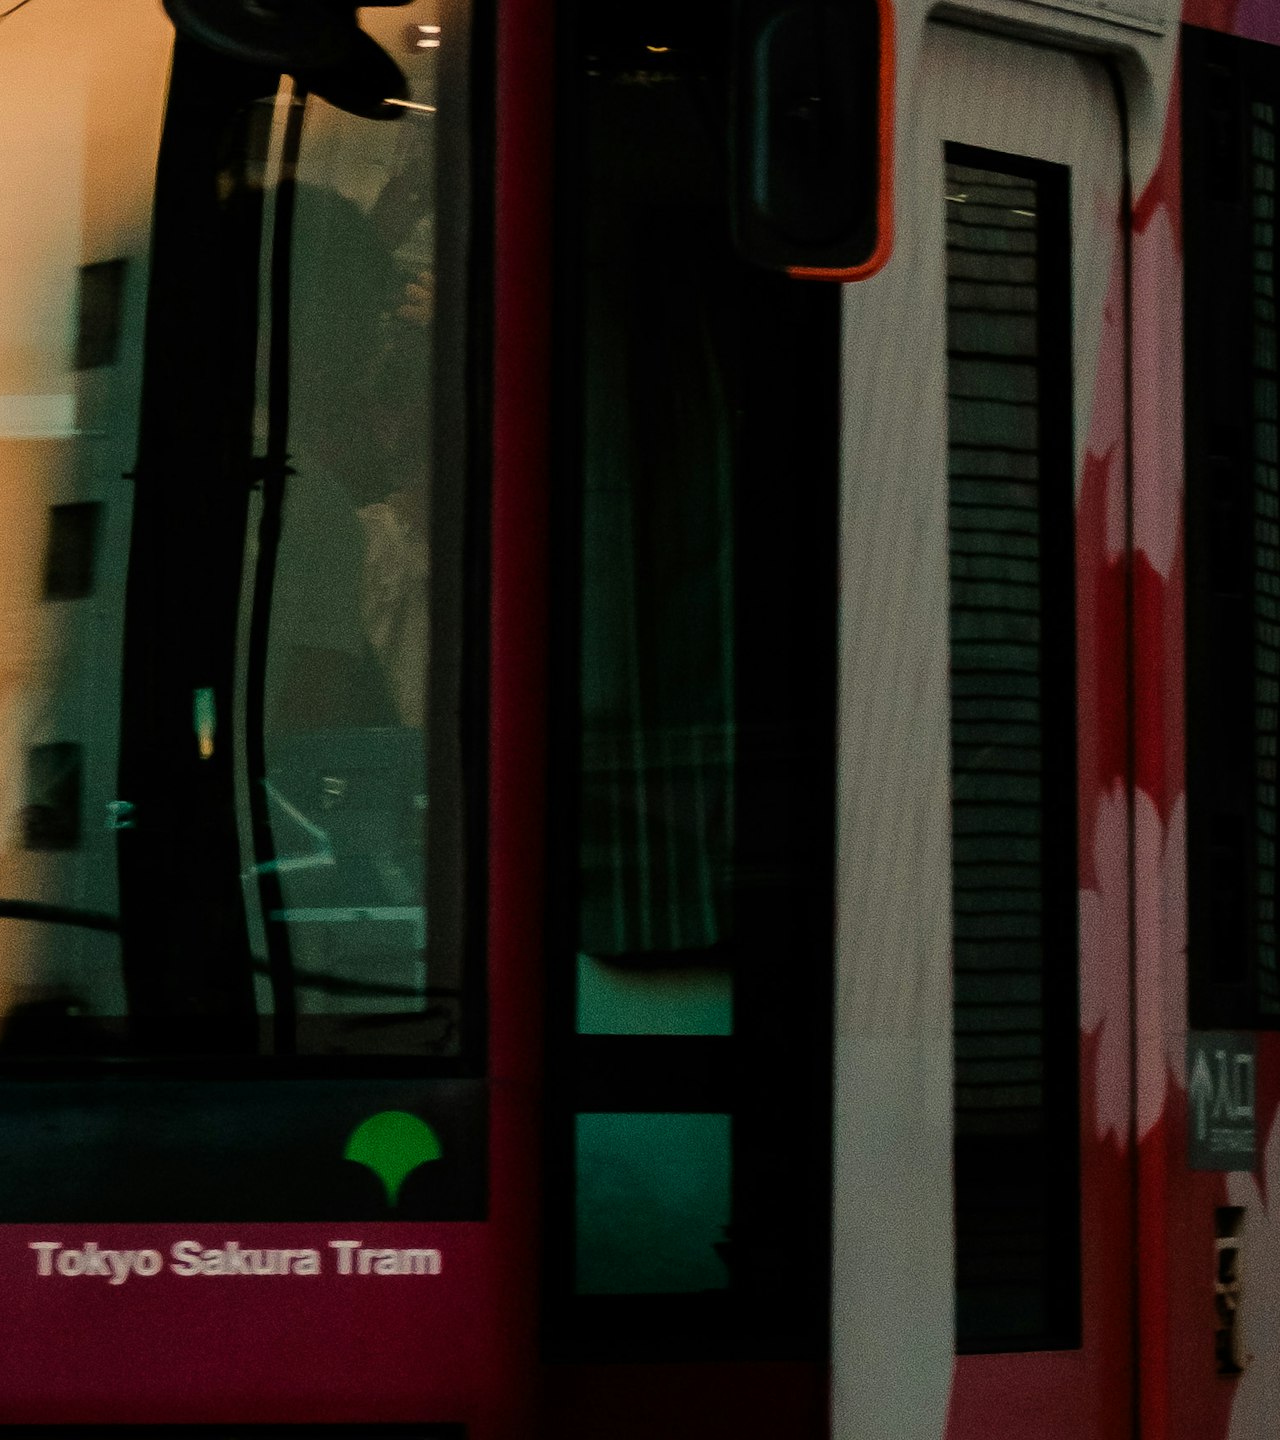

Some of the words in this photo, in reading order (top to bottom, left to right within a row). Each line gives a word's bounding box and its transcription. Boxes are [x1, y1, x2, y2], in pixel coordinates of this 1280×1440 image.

[27, 1240, 164, 1286] Tokyo
[170, 1239, 321, 1277] Sakura
[327, 1239, 443, 1277] Tram
